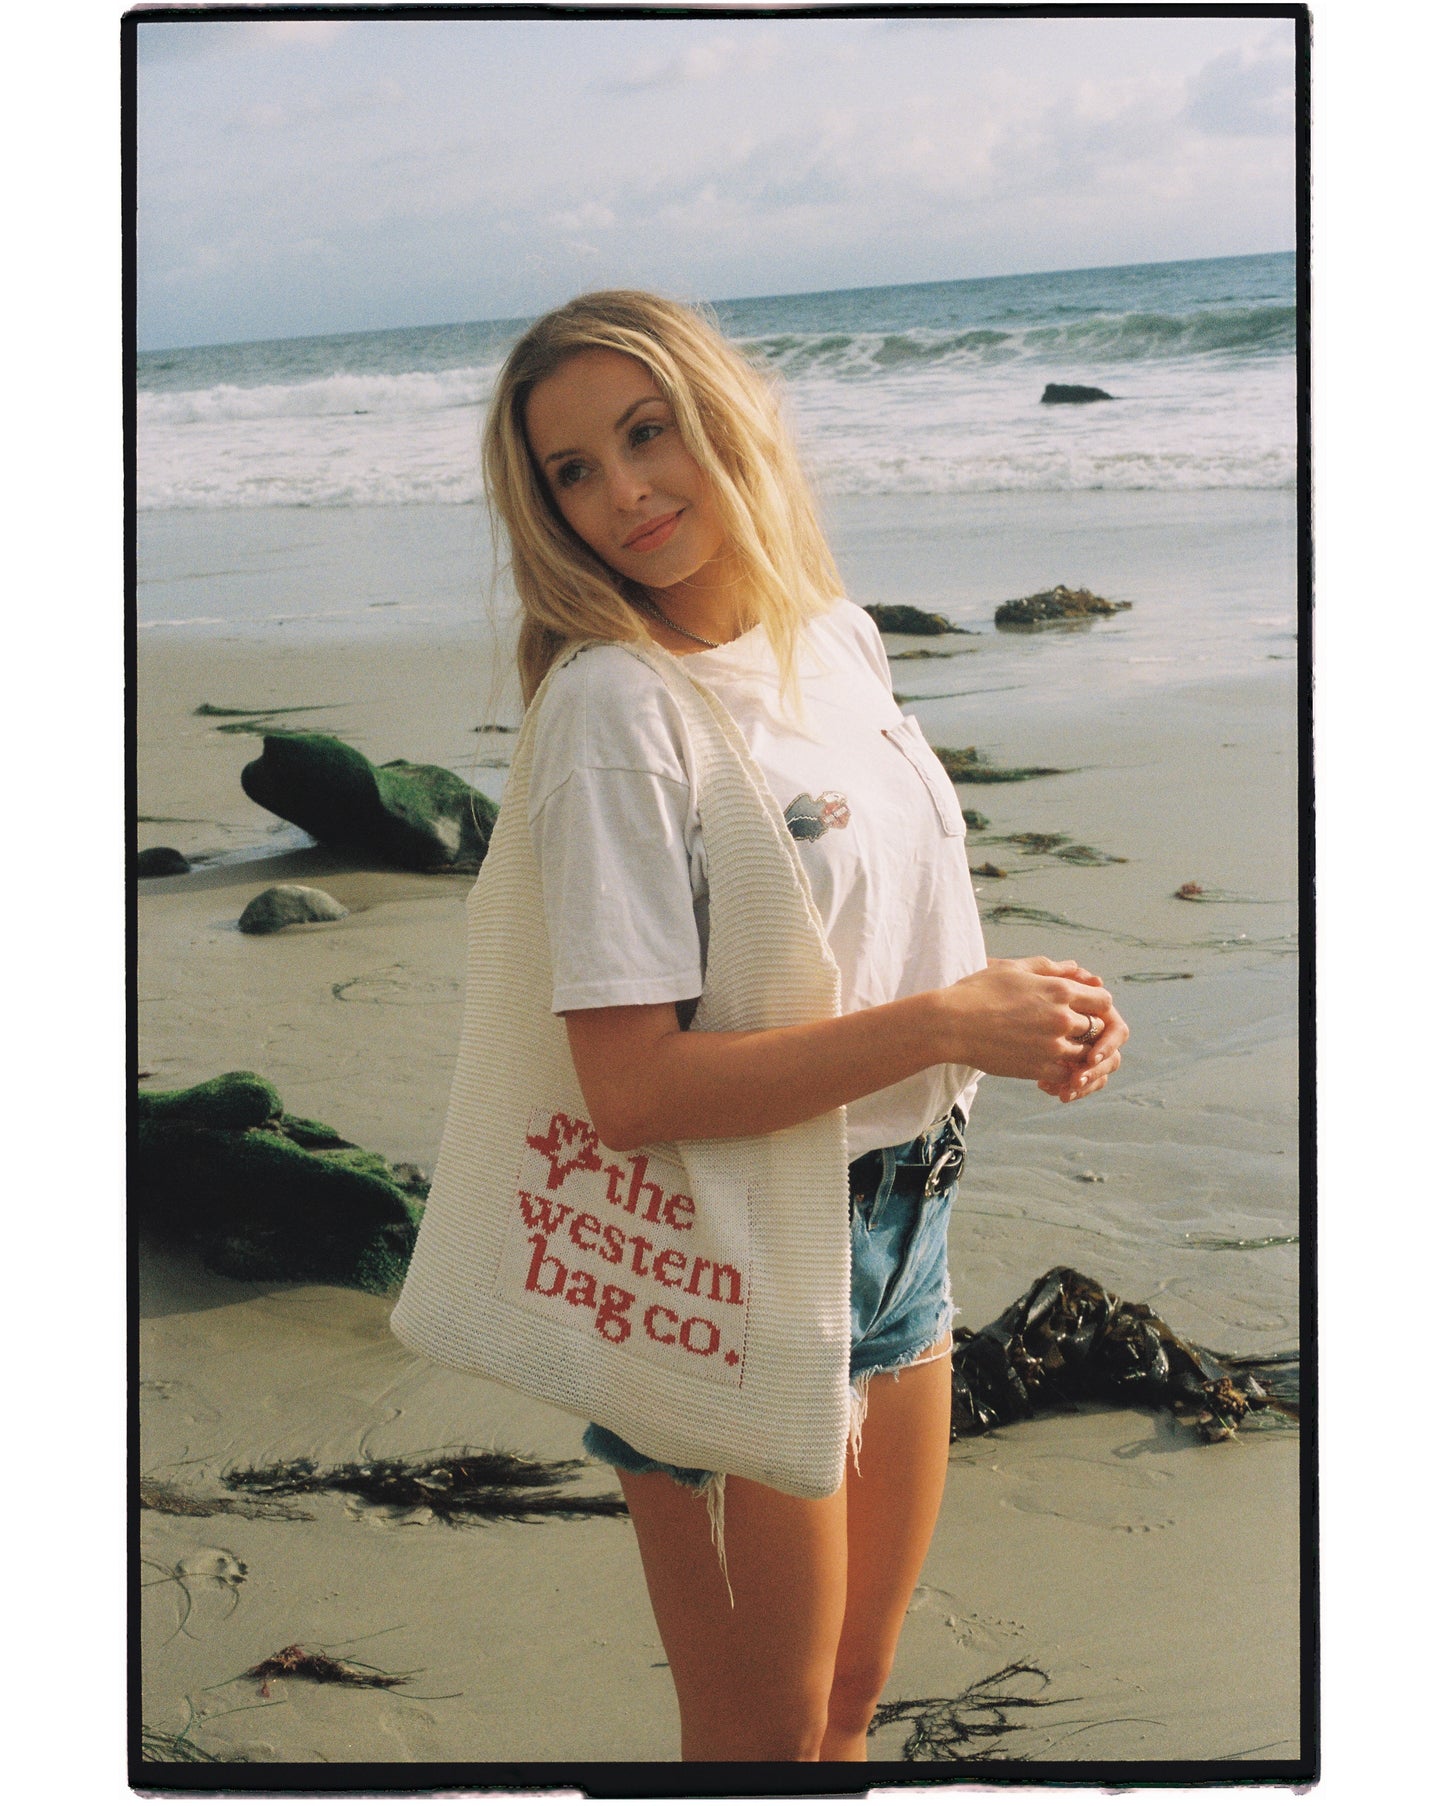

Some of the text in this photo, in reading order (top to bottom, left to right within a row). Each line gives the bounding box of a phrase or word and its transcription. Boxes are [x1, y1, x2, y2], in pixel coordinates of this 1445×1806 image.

[518, 1190, 744, 1305] western
[604, 1154, 696, 1231] the
[524, 1232, 740, 1366] bag co.
